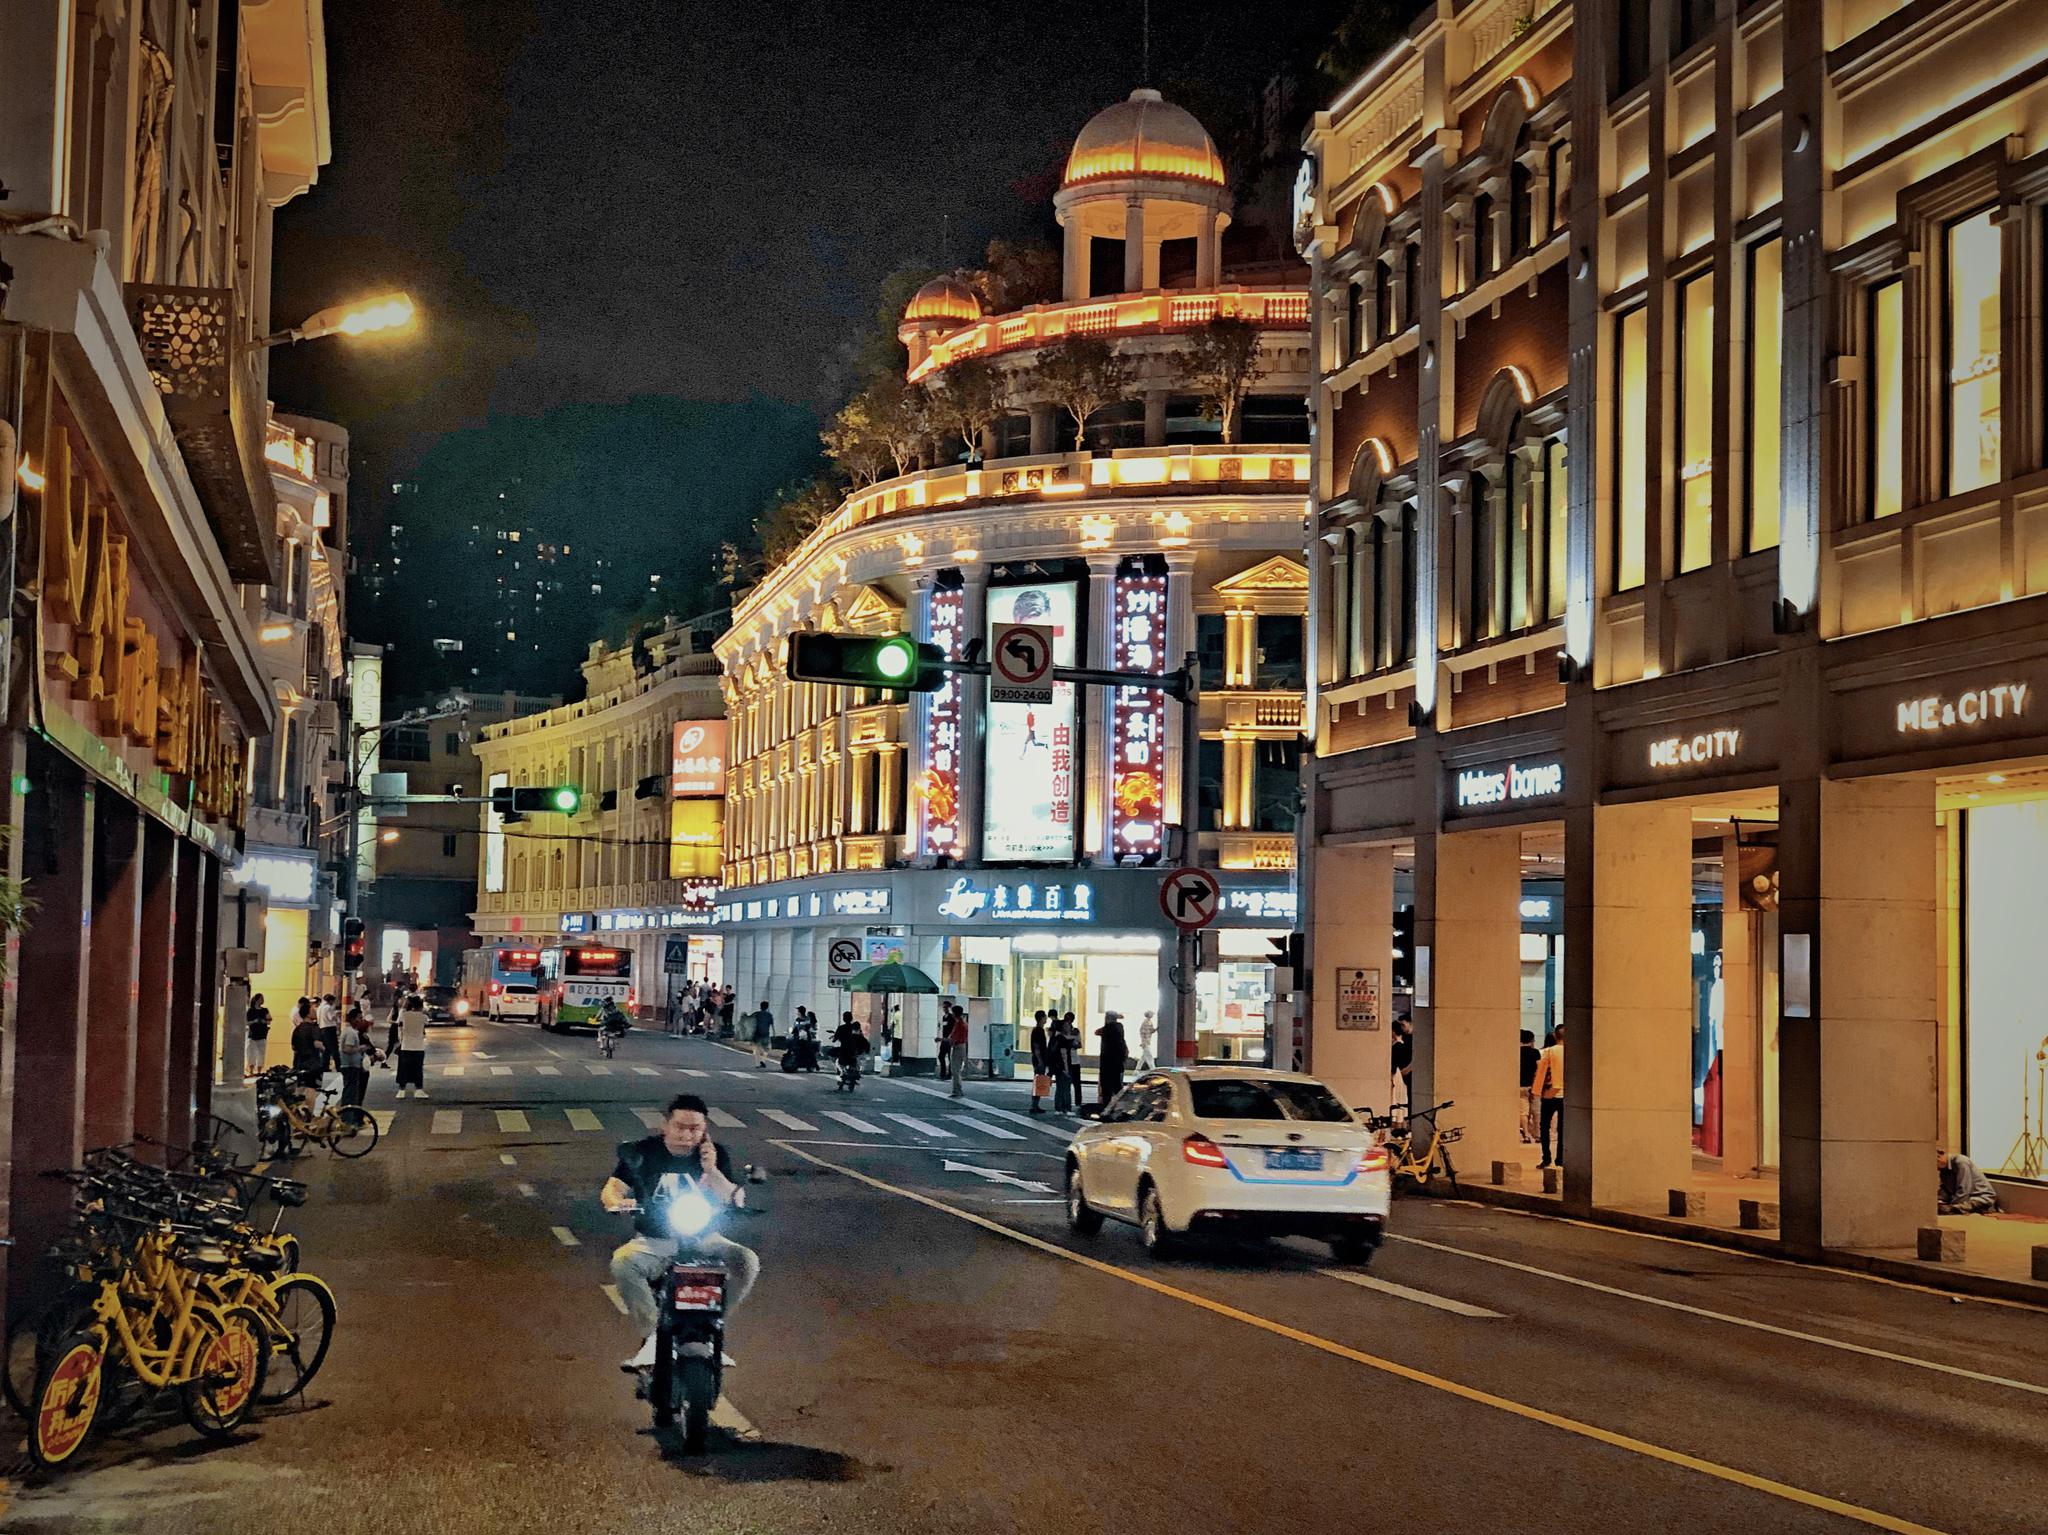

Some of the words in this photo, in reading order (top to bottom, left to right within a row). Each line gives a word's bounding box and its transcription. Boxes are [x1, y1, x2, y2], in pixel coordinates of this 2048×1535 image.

[361, 669, 381, 721] Calvin
[993, 689, 1050, 700] 09:00-24:00
[1897, 684, 2027, 732] ME&CITY
[1650, 729, 1739, 767] ME&CITY
[1051, 723, 1071, 823] 由我创造
